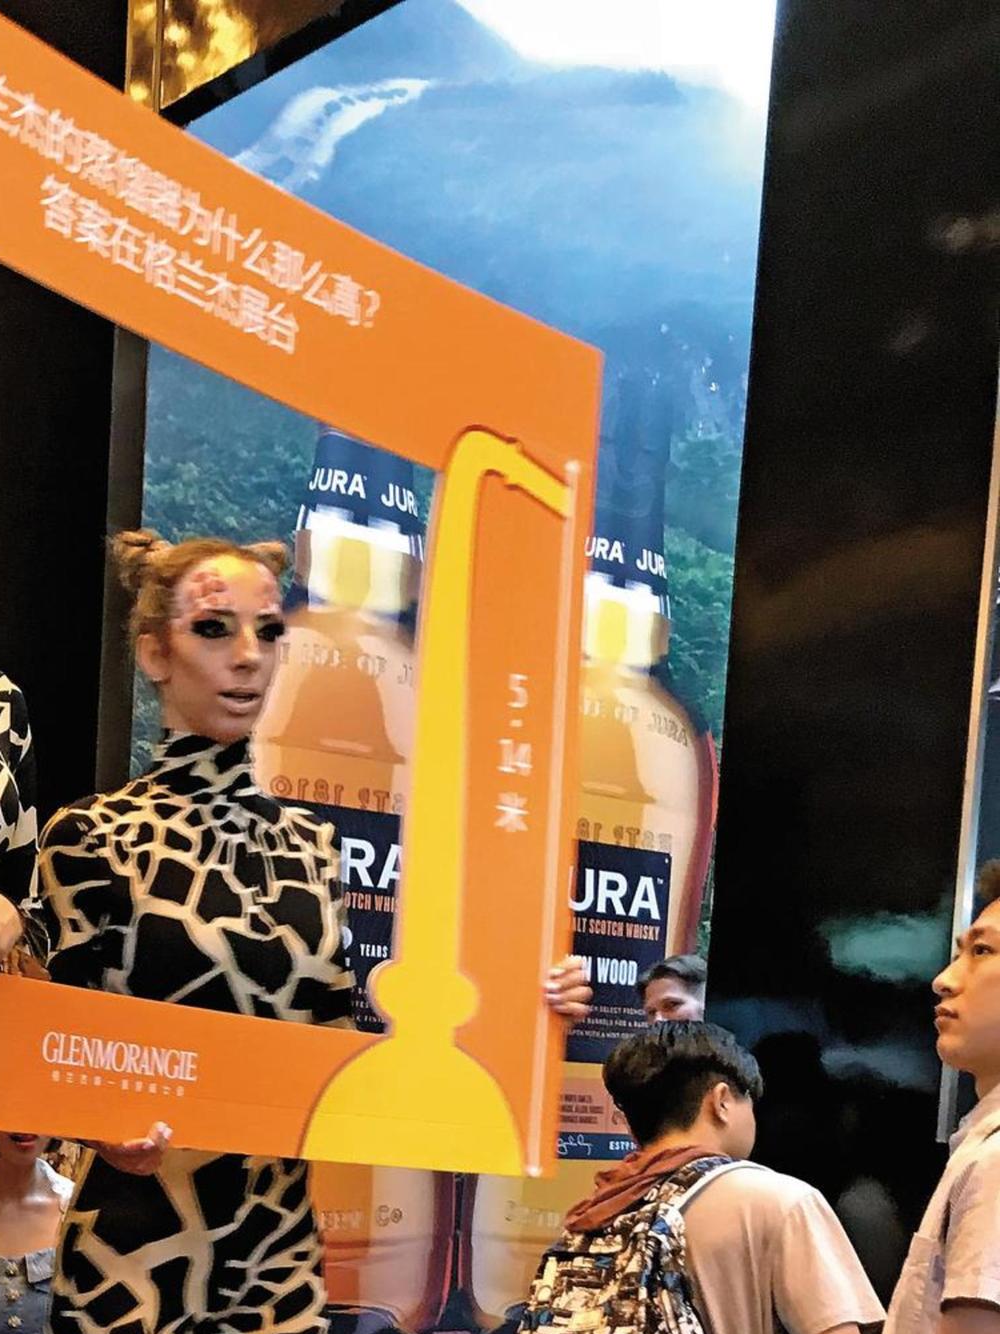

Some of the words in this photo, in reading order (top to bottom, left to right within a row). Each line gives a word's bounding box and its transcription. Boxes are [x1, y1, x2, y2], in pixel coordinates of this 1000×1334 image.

[309, 467, 367, 499] JURA
[381, 483, 418, 517] JUR
[583, 536, 625, 565] URA
[636, 549, 668, 580] JUR
[341, 836, 403, 889] RA
[344, 891, 371, 911] OTCH
[568, 866, 661, 921] URA
[360, 943, 389, 958] YEARS
[589, 918, 624, 937] SCOTCH
[626, 922, 661, 941] WHISKY
[597, 956, 638, 986] WOOD
[42, 1031, 199, 1082] GLENMORANGIE
